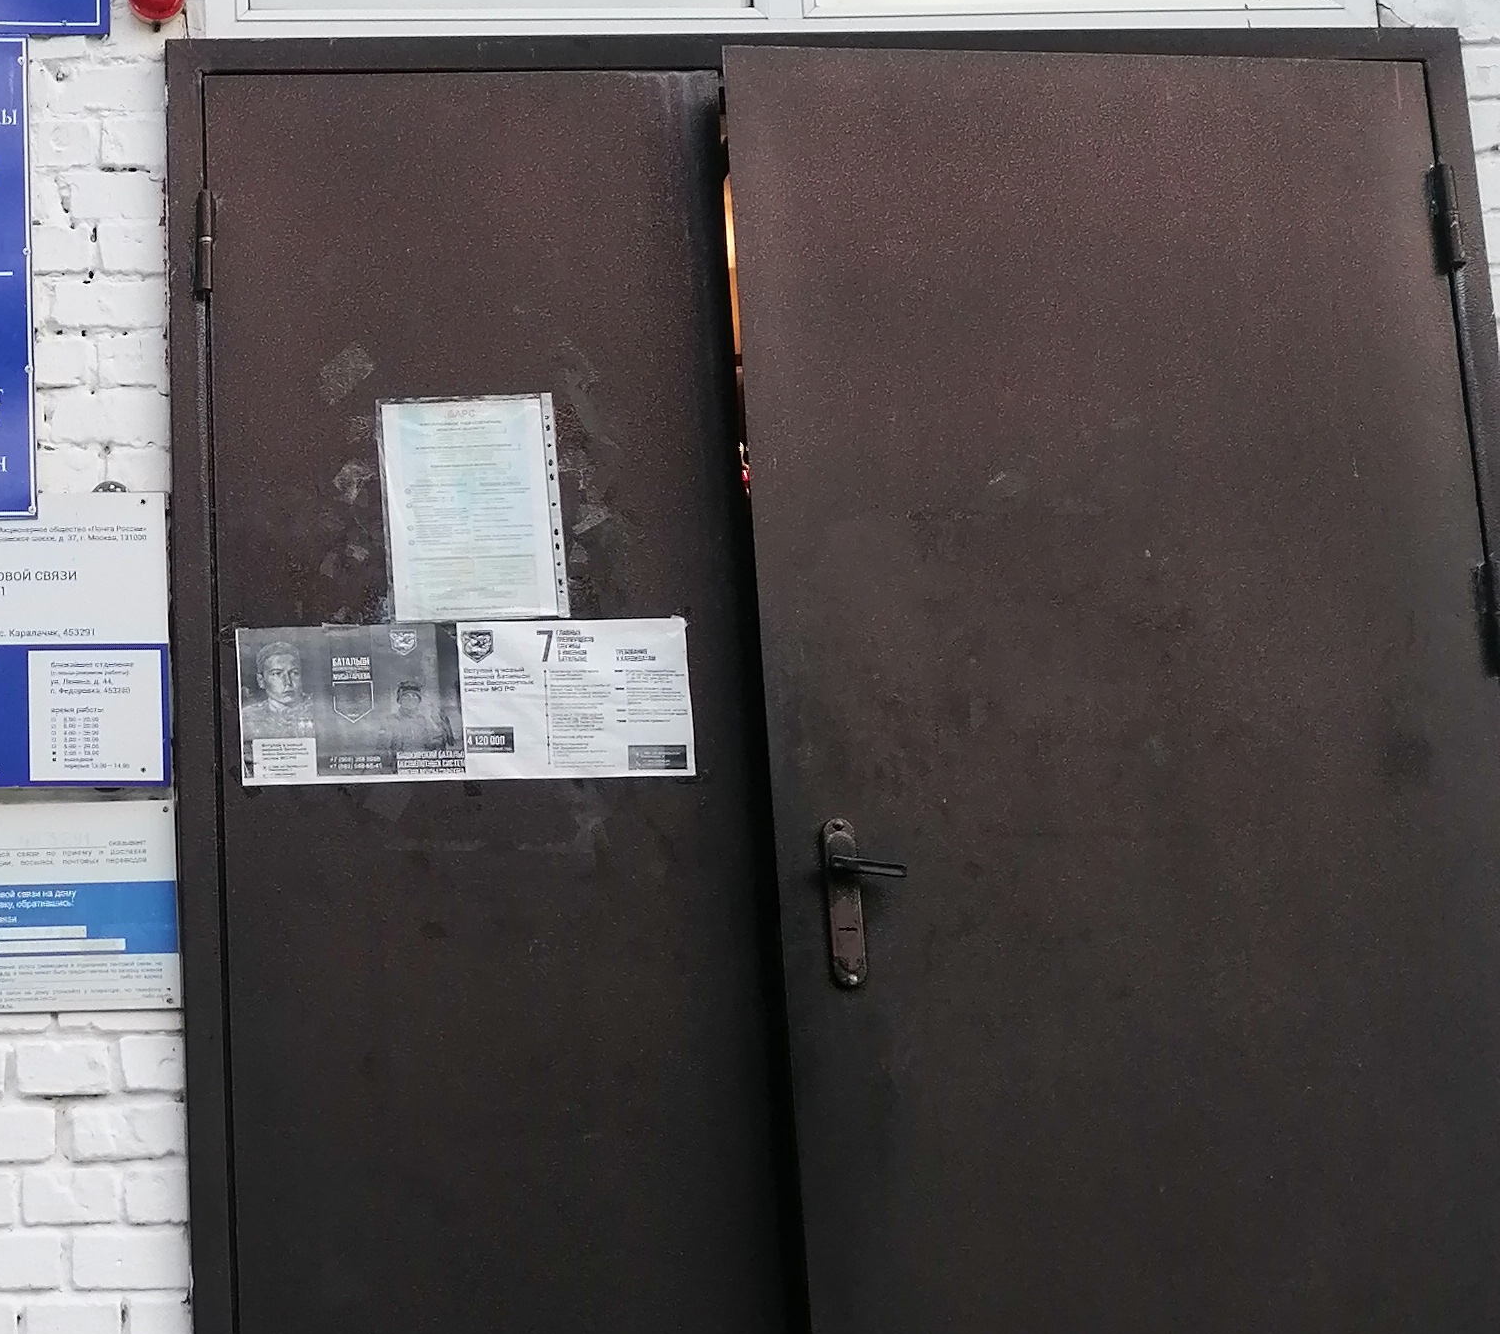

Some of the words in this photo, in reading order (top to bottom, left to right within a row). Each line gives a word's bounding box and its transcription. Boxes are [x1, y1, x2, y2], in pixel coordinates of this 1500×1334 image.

[35, 571, 77, 581] СВЯЗИ
[63, 628, 95, 637] 453291
[537, 630, 553, 662] 7
[467, 736, 472, 745] 4
